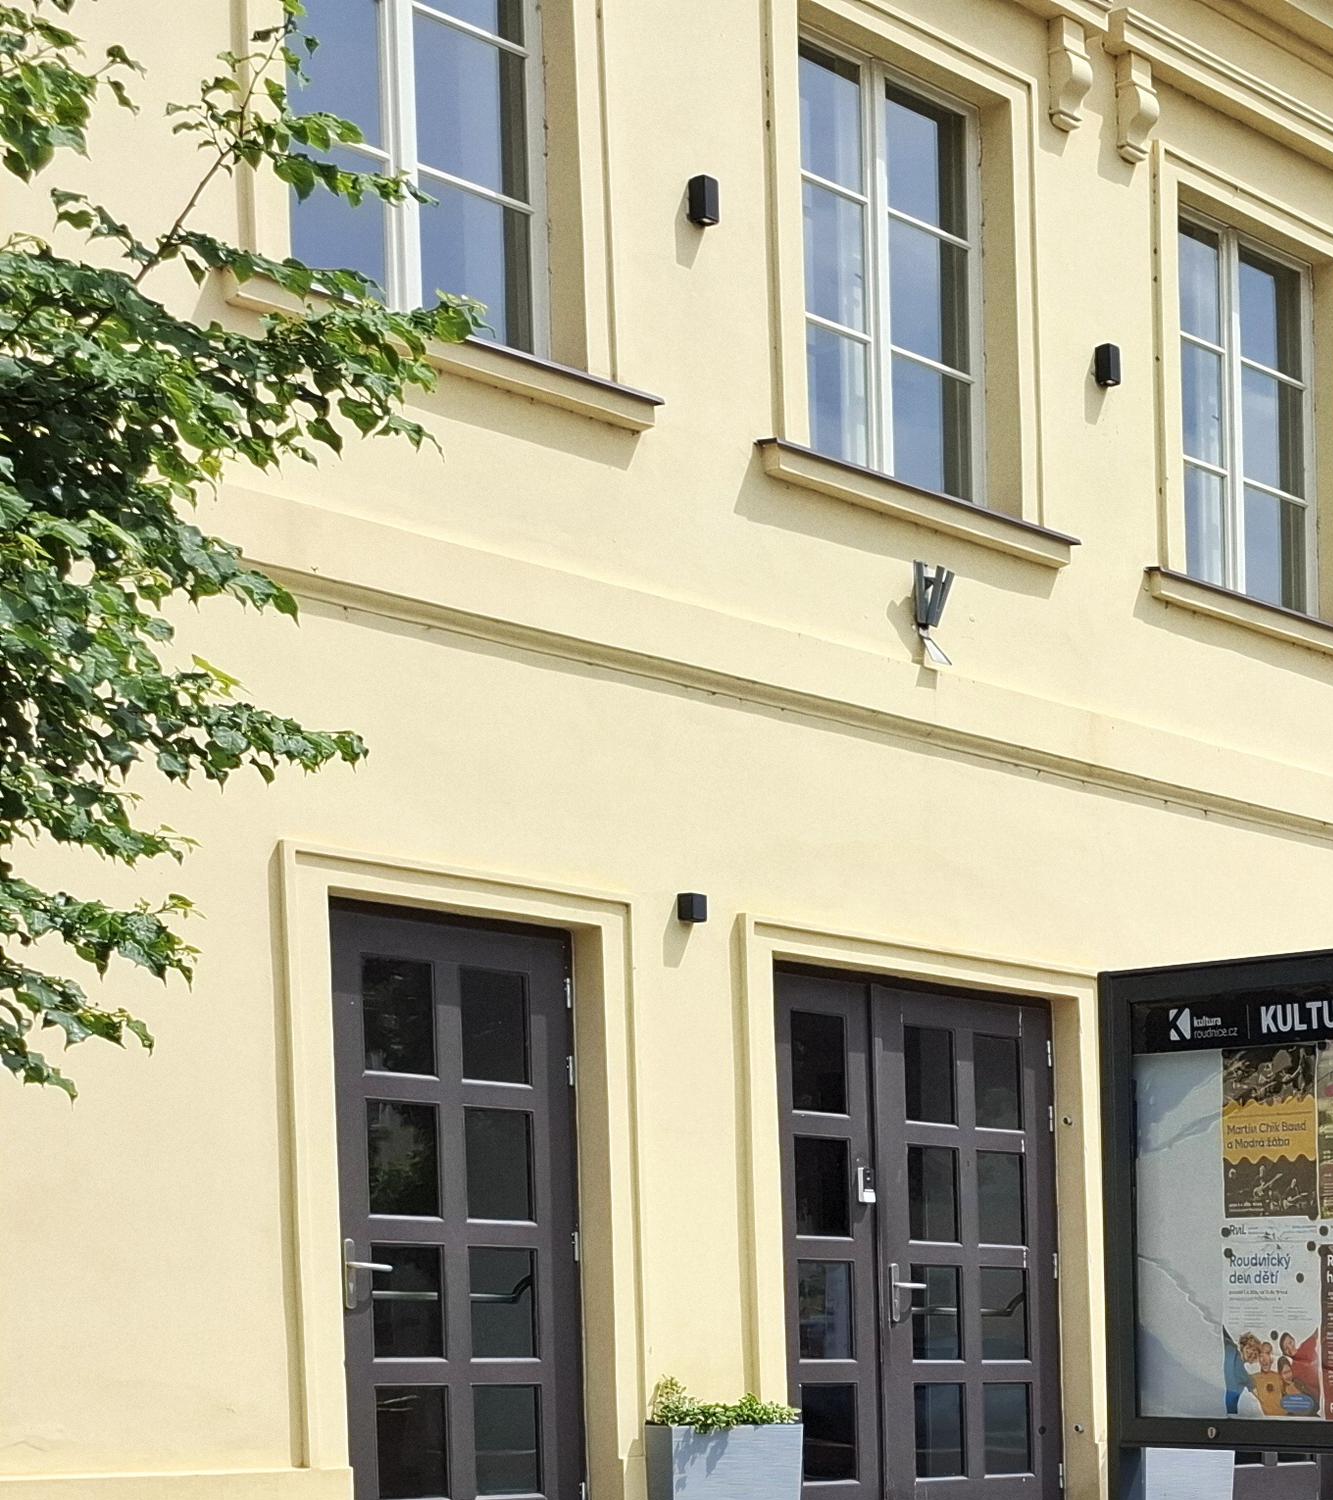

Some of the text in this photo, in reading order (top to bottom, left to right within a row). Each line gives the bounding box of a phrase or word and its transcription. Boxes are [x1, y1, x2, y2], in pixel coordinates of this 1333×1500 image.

[1193, 1015, 1222, 1028] kultura
[1193, 1027, 1239, 1039] roudnice.cz
[1229, 1252, 1291, 1270] Roudnický
[1229, 1270, 1279, 1284] den dětí
